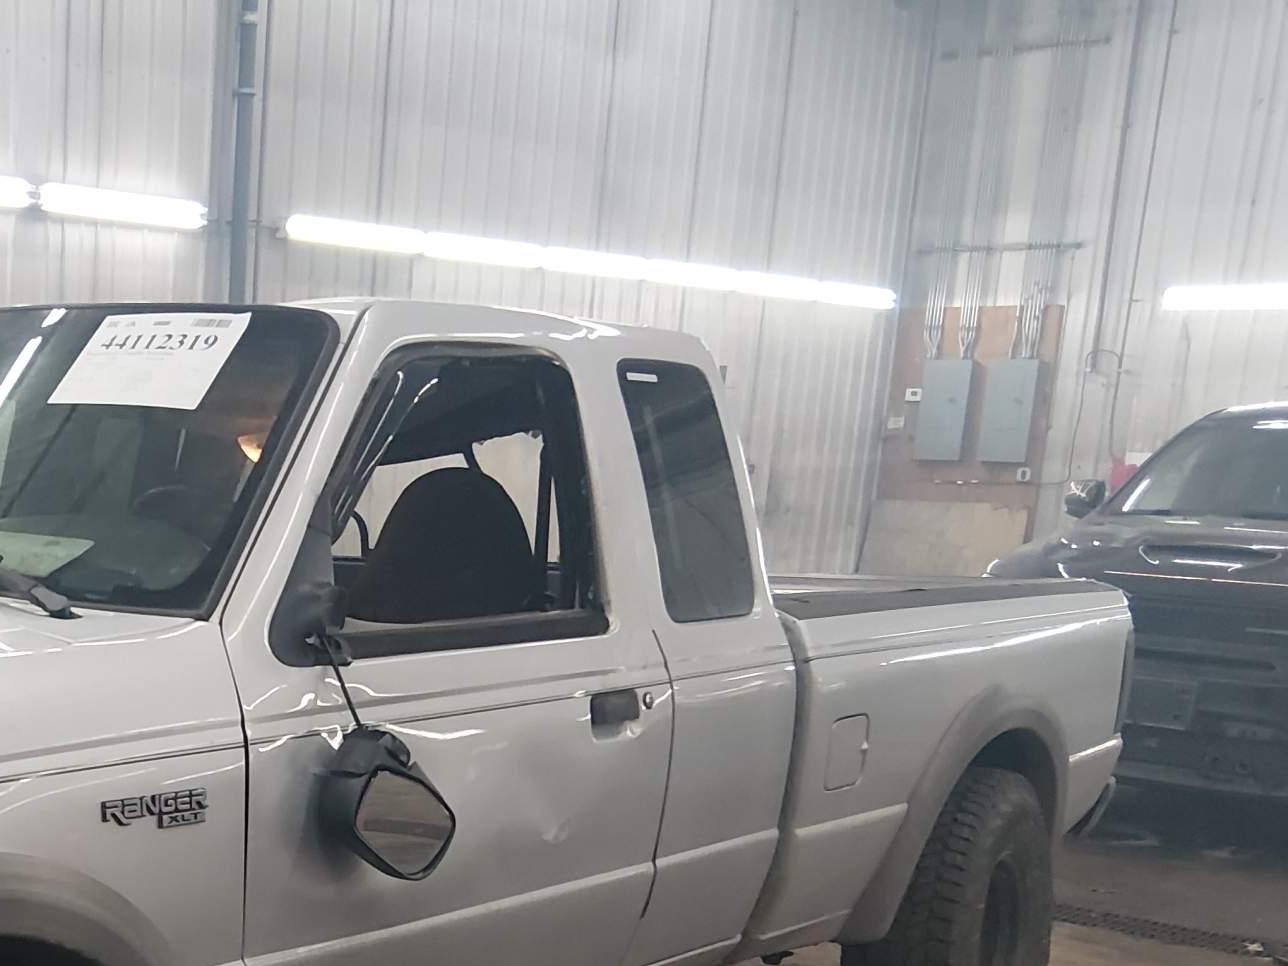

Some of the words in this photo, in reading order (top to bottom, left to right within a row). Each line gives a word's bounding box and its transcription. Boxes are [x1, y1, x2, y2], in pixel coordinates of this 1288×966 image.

[100, 333, 219, 352] 44112319
[101, 788, 208, 826] RANGER
[167, 811, 203, 825] XLT
